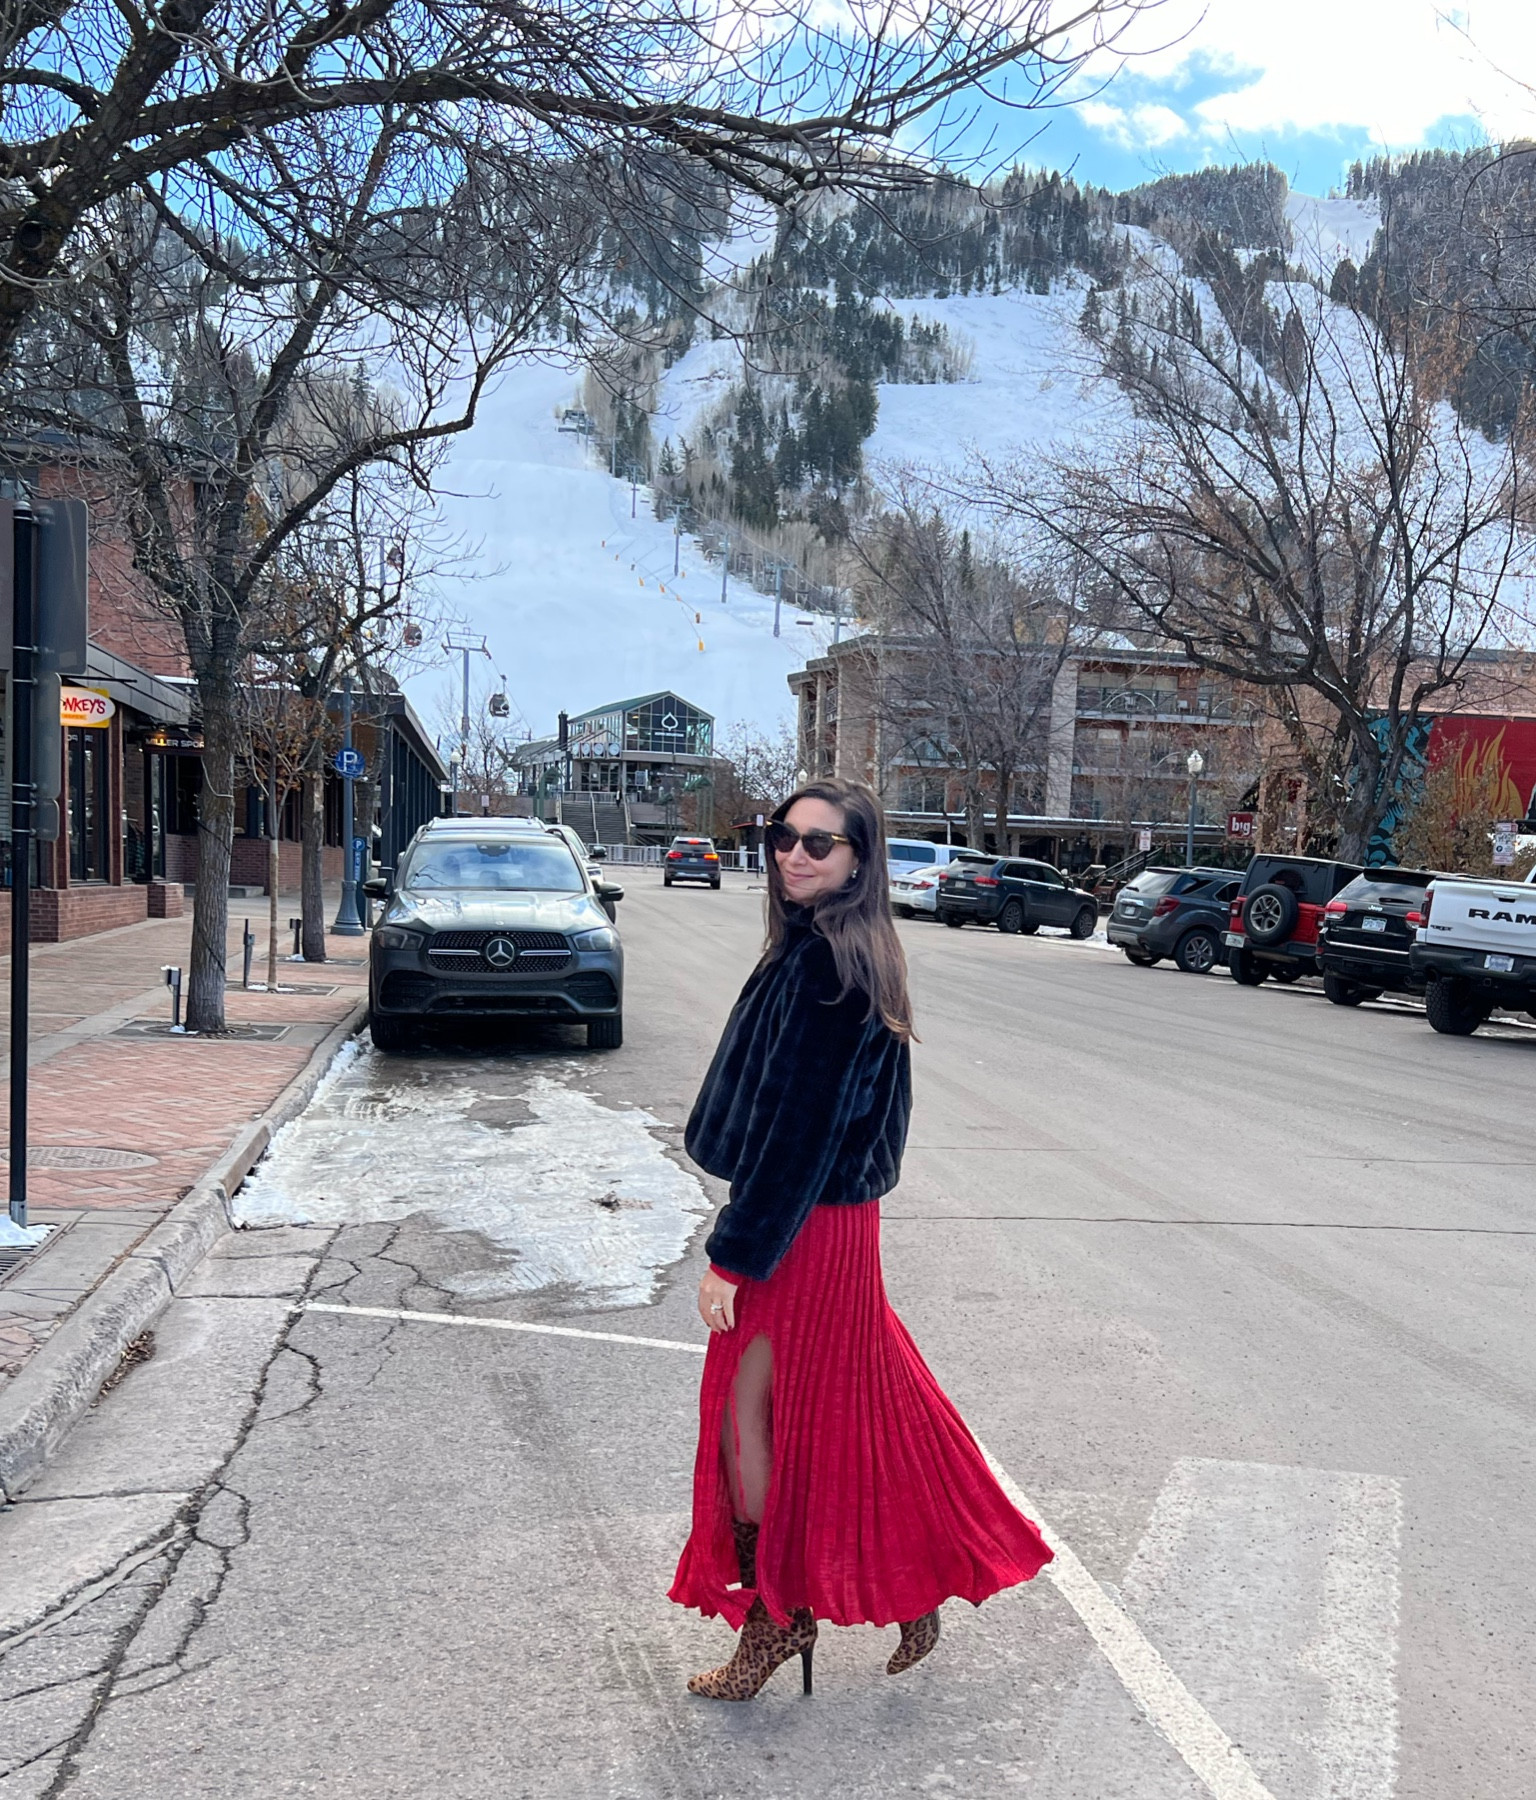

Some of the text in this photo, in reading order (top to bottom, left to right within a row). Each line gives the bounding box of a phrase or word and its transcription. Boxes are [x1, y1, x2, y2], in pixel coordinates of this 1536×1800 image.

[64, 697, 106, 715] NKEY'S
[180, 739, 205, 748] SPOR
[343, 751, 358, 772] P
[1231, 816, 1251, 836] big
[1468, 908, 1536, 926] RAM
